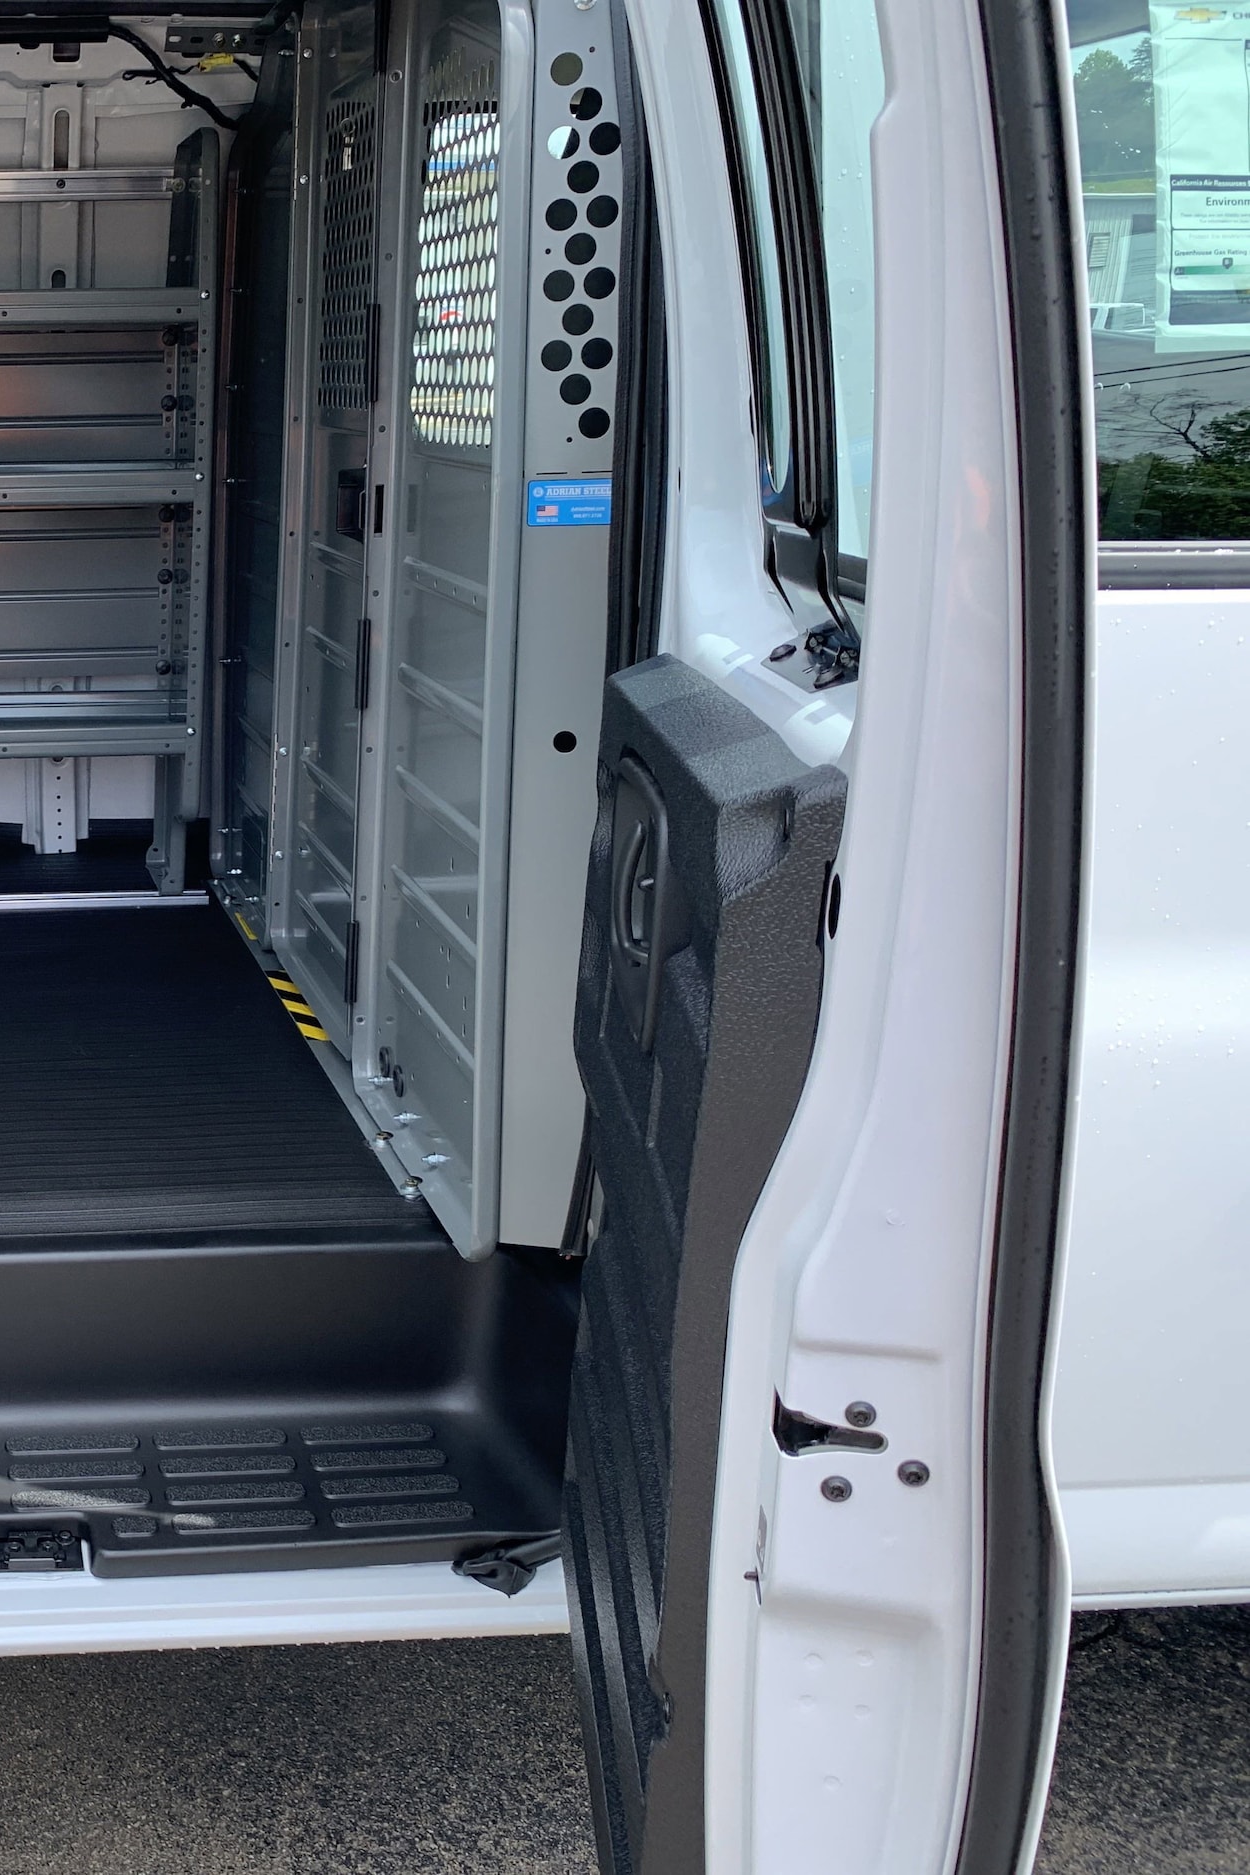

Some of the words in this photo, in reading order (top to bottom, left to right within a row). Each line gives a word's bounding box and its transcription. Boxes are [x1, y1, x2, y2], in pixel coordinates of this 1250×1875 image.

[1227, 248, 1248, 256] Rating
[546, 487, 581, 496] ADRIAN
[583, 486, 612, 495] STEEL
